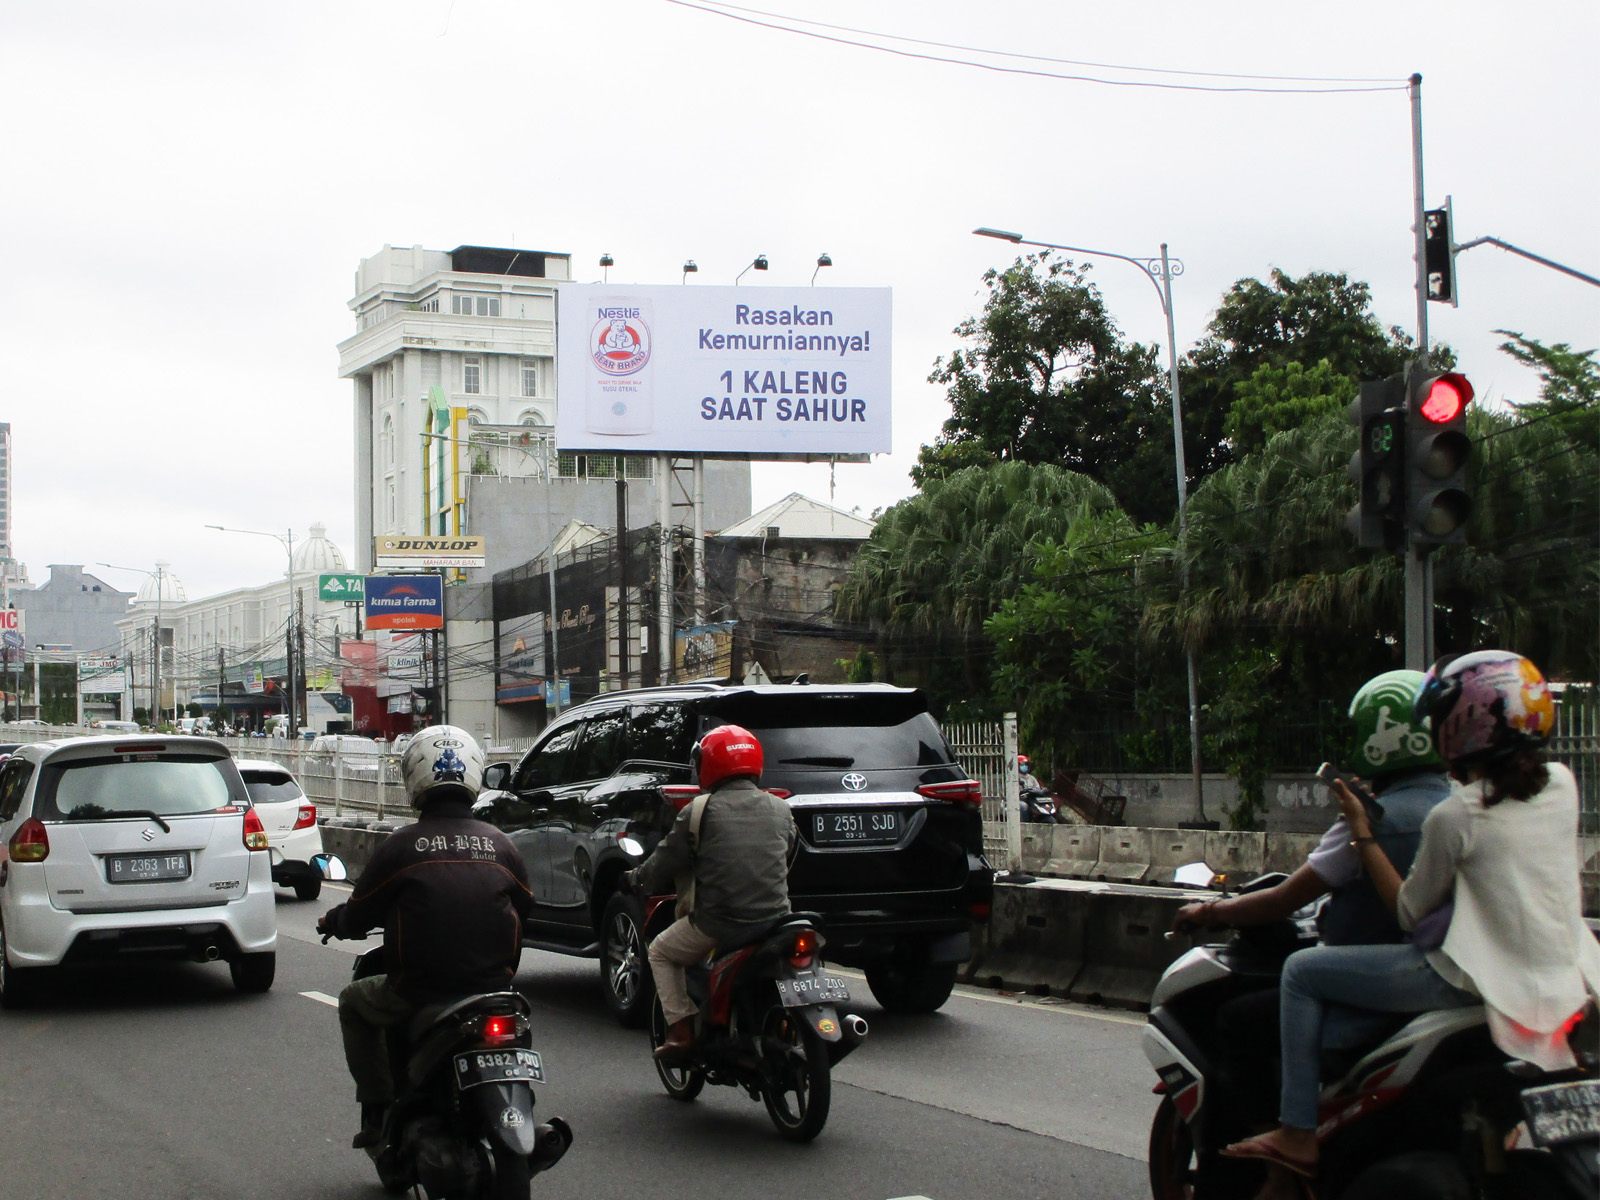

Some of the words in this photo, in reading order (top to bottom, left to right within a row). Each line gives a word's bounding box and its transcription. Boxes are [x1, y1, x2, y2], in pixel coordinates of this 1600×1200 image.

[736, 304, 833, 326] Rasakan
[699, 328, 870, 356] Kemurniannya!
[594, 351, 615, 368] BEAR
[617, 351, 646, 369] BRAND
[720, 370, 733, 394] 1
[744, 370, 847, 395] KALENG
[701, 396, 767, 421] SAAT
[776, 397, 866, 422] SAHUR
[396, 540, 478, 550] DUNLOP
[346, 579, 364, 592] TA
[371, 597, 401, 606] kimia
[403, 596, 436, 607] farma
[392, 616, 416, 625] apotek
[397, 658, 418, 666] klinik
[726, 743, 755, 752] SUZUKI
[816, 816, 825, 832] B
[834, 815, 863, 831] 2551
[872, 814, 895, 831] SJD
[471, 850, 497, 861] Motor
[114, 860, 122, 873] B
[130, 858, 158, 872] 2363
[164, 856, 185, 870] TFA
[779, 982, 787, 993] B
[793, 980, 820, 992] 6874
[458, 1058, 469, 1073] B
[476, 1053, 513, 1068] 6382
